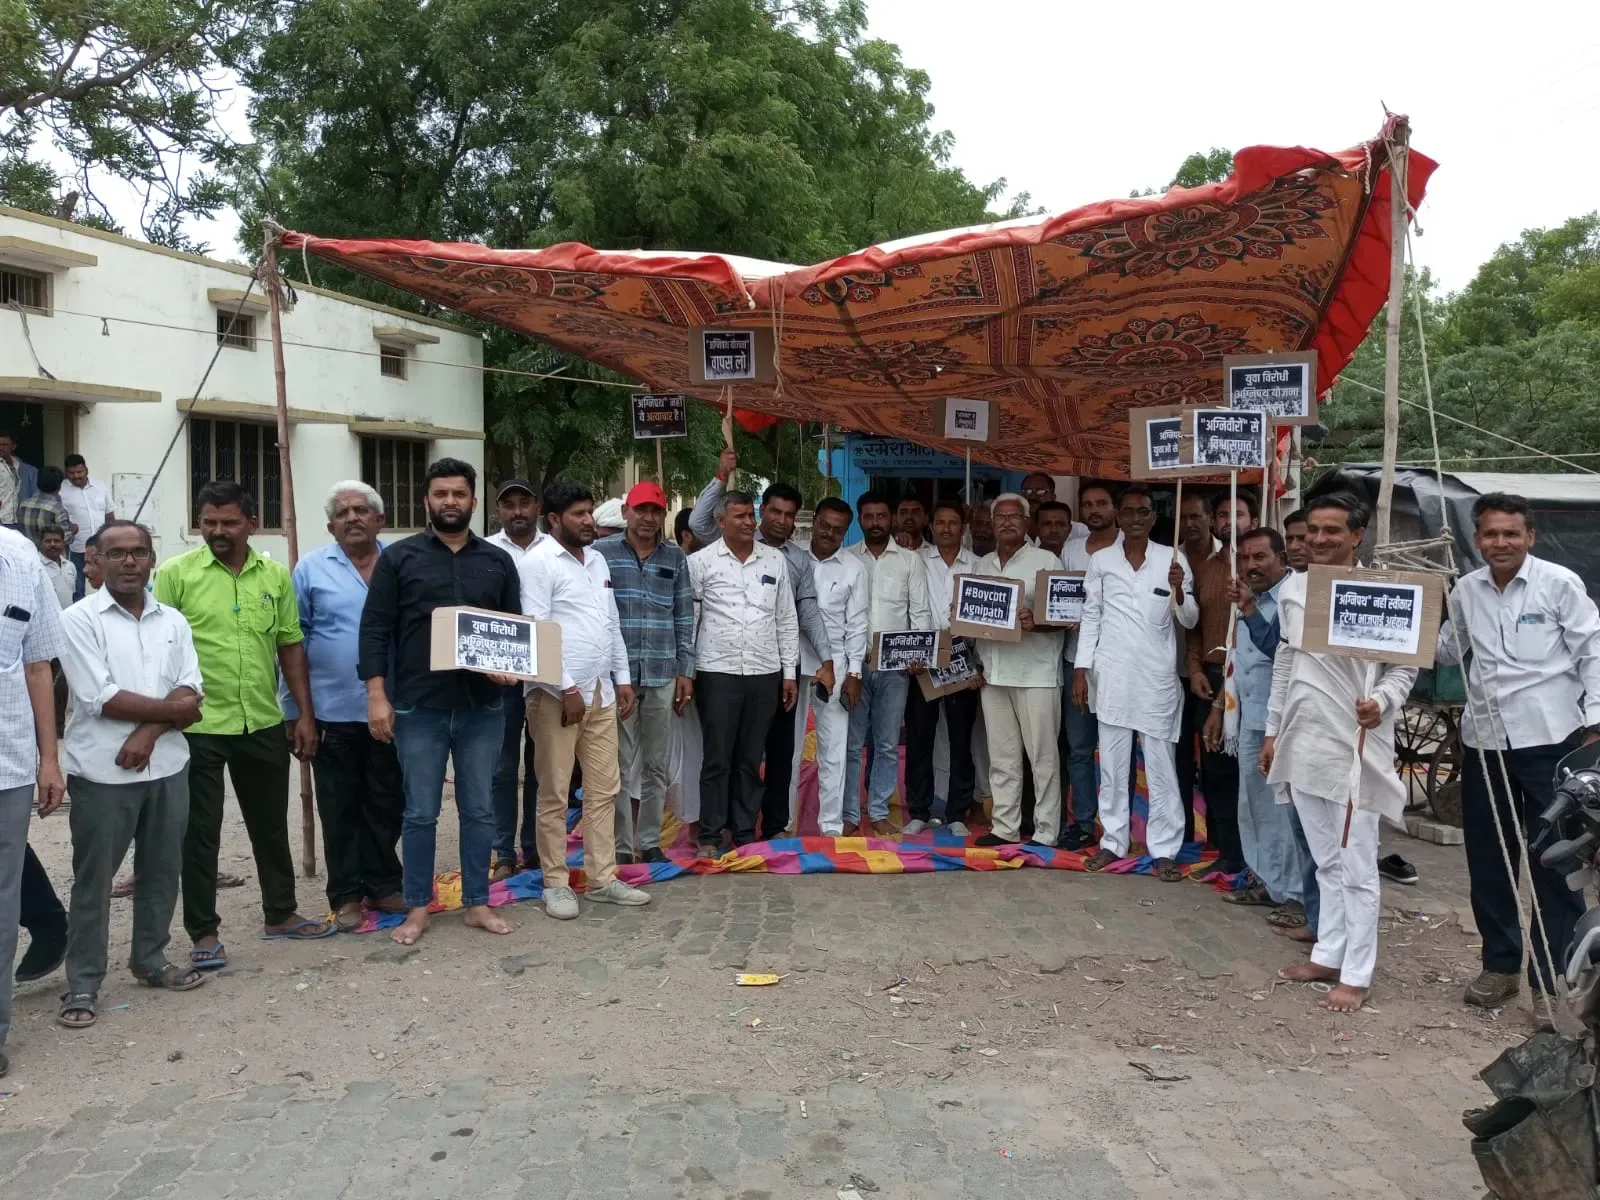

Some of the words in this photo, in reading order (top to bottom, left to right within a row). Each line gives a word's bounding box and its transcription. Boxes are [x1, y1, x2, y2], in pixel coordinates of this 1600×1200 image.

[711, 355, 732, 370] वापस
[734, 351, 747, 369] लो
[1244, 373, 1261, 386] युवा
[1262, 370, 1289, 383] विरोधी
[1235, 387, 1269, 400] अग्निपथ
[1270, 386, 1299, 399] योजना
[646, 411, 673, 422] अत्याचार
[1250, 418, 1260, 433] से
[965, 586, 1007, 603] #Boycott
[1335, 591, 1372, 607] "अग्निपथ"
[1373, 595, 1388, 608] नहीं
[1388, 595, 1412, 611] स्वीकार
[962, 603, 1004, 619] Agnipath
[1339, 609, 1356, 628] टूटेगा
[1357, 613, 1384, 626] भाजपाई
[1385, 614, 1409, 629] अहंकार
[472, 620, 489, 634] युवा
[490, 621, 518, 637] विरोधी
[459, 635, 498, 650] अग्निपथ
[500, 639, 528, 655] योजना
[925, 635, 933, 646] से
[950, 655, 969, 674] करो
